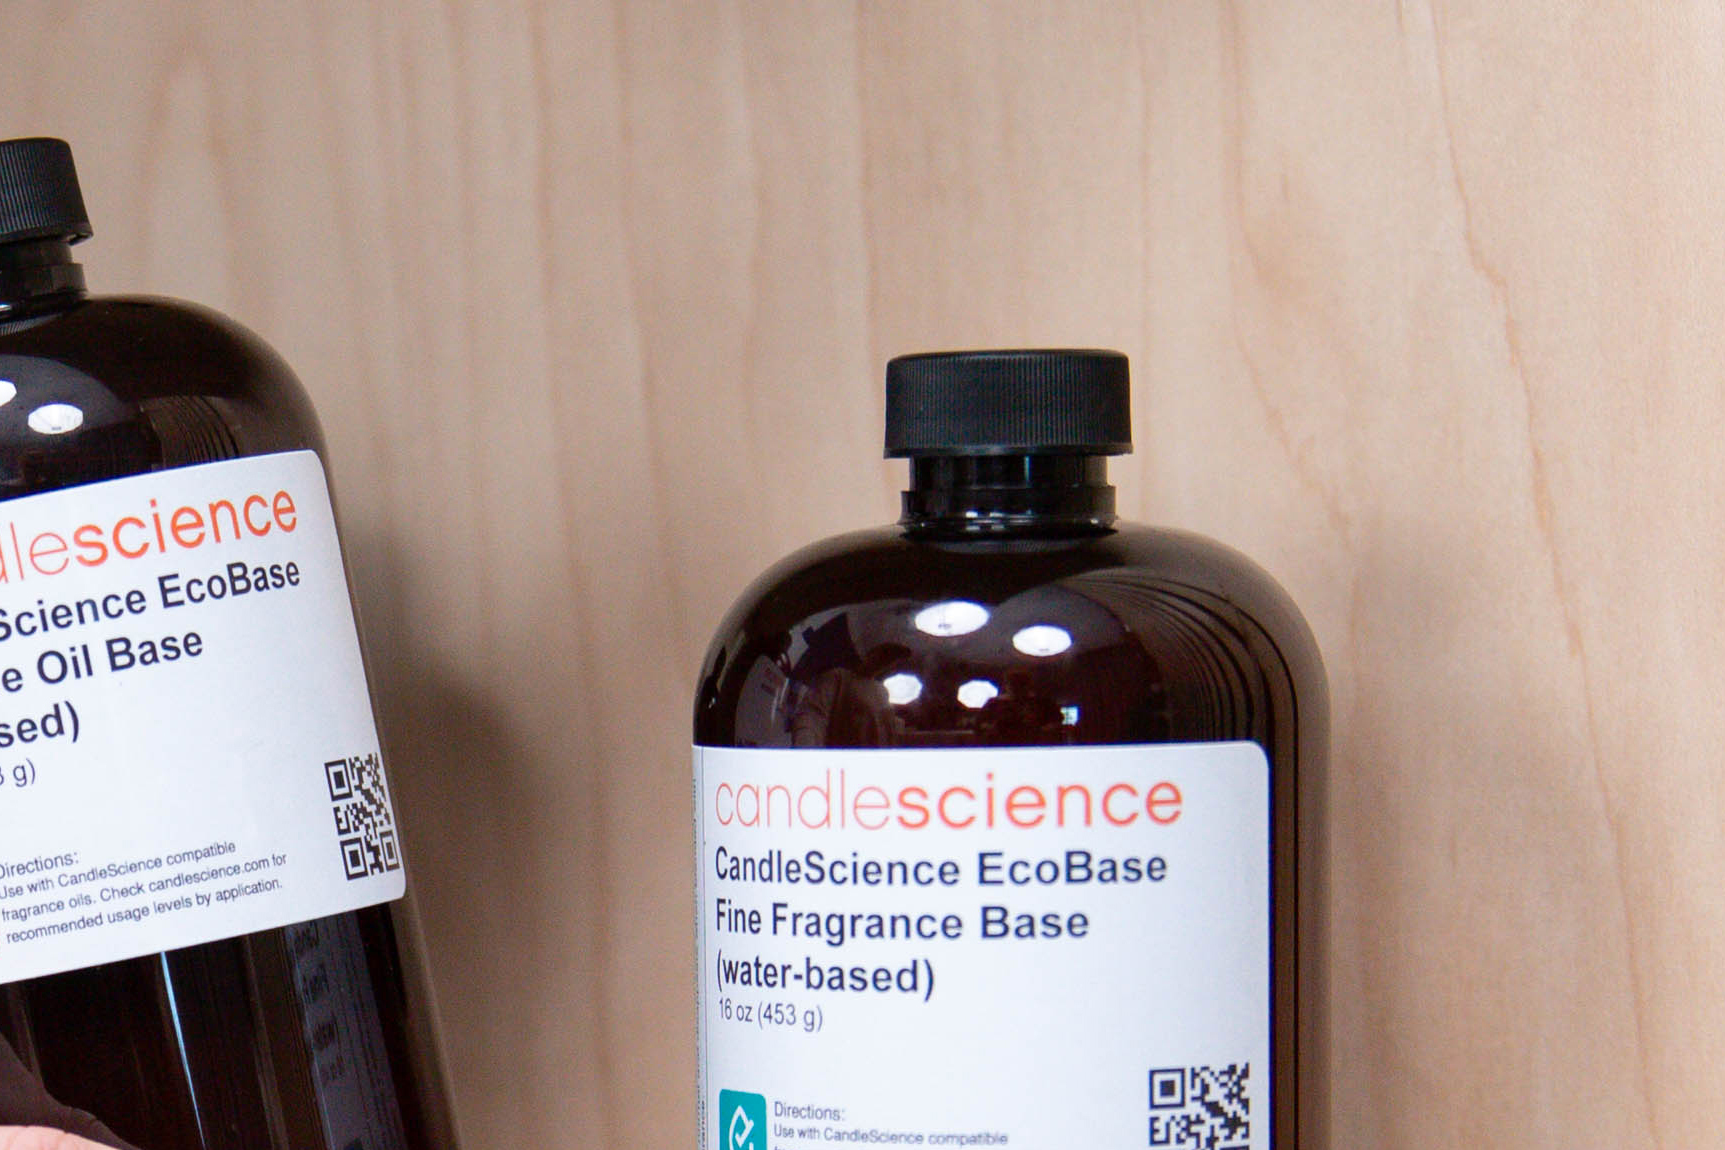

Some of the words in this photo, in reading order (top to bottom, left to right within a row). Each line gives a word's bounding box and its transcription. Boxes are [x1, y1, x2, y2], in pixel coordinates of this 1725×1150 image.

[157, 560, 301, 609] EcoBase
[36, 643, 94, 684] Oil
[105, 630, 203, 673] Base
[12, 758, 36, 788] g)
[715, 768, 1184, 831] candlescience
[1, 901, 65, 923] fragrance
[68, 893, 97, 909] oils.
[99, 882, 145, 902] Check
[148, 855, 270, 893] candlescience.com
[272, 852, 288, 867] for
[27, 876, 55, 894] with
[57, 857, 163, 888] CandleScience
[166, 841, 236, 867] compatible
[715, 845, 962, 887] CandleScience
[977, 850, 1169, 887] EcoBase
[5, 911, 104, 944] recommended
[107, 906, 151, 924] usage
[153, 895, 193, 914] levels
[195, 890, 212, 910] by
[215, 877, 283, 903] application.
[715, 897, 762, 934] Fine
[772, 902, 965, 947] Fragrance
[980, 904, 1091, 940] Base
[716, 949, 936, 1001] (water-based)
[718, 997, 733, 1022] 16
[735, 1003, 753, 1023] oz
[757, 1001, 797, 1030] (453
[803, 1005, 824, 1032] g)
[774, 1101, 846, 1122] Directions:
[774, 1124, 795, 1138] Use
[797, 1126, 820, 1140] with
[824, 1127, 925, 1145] CandleScience
[928, 1132, 1009, 1148] compatible
